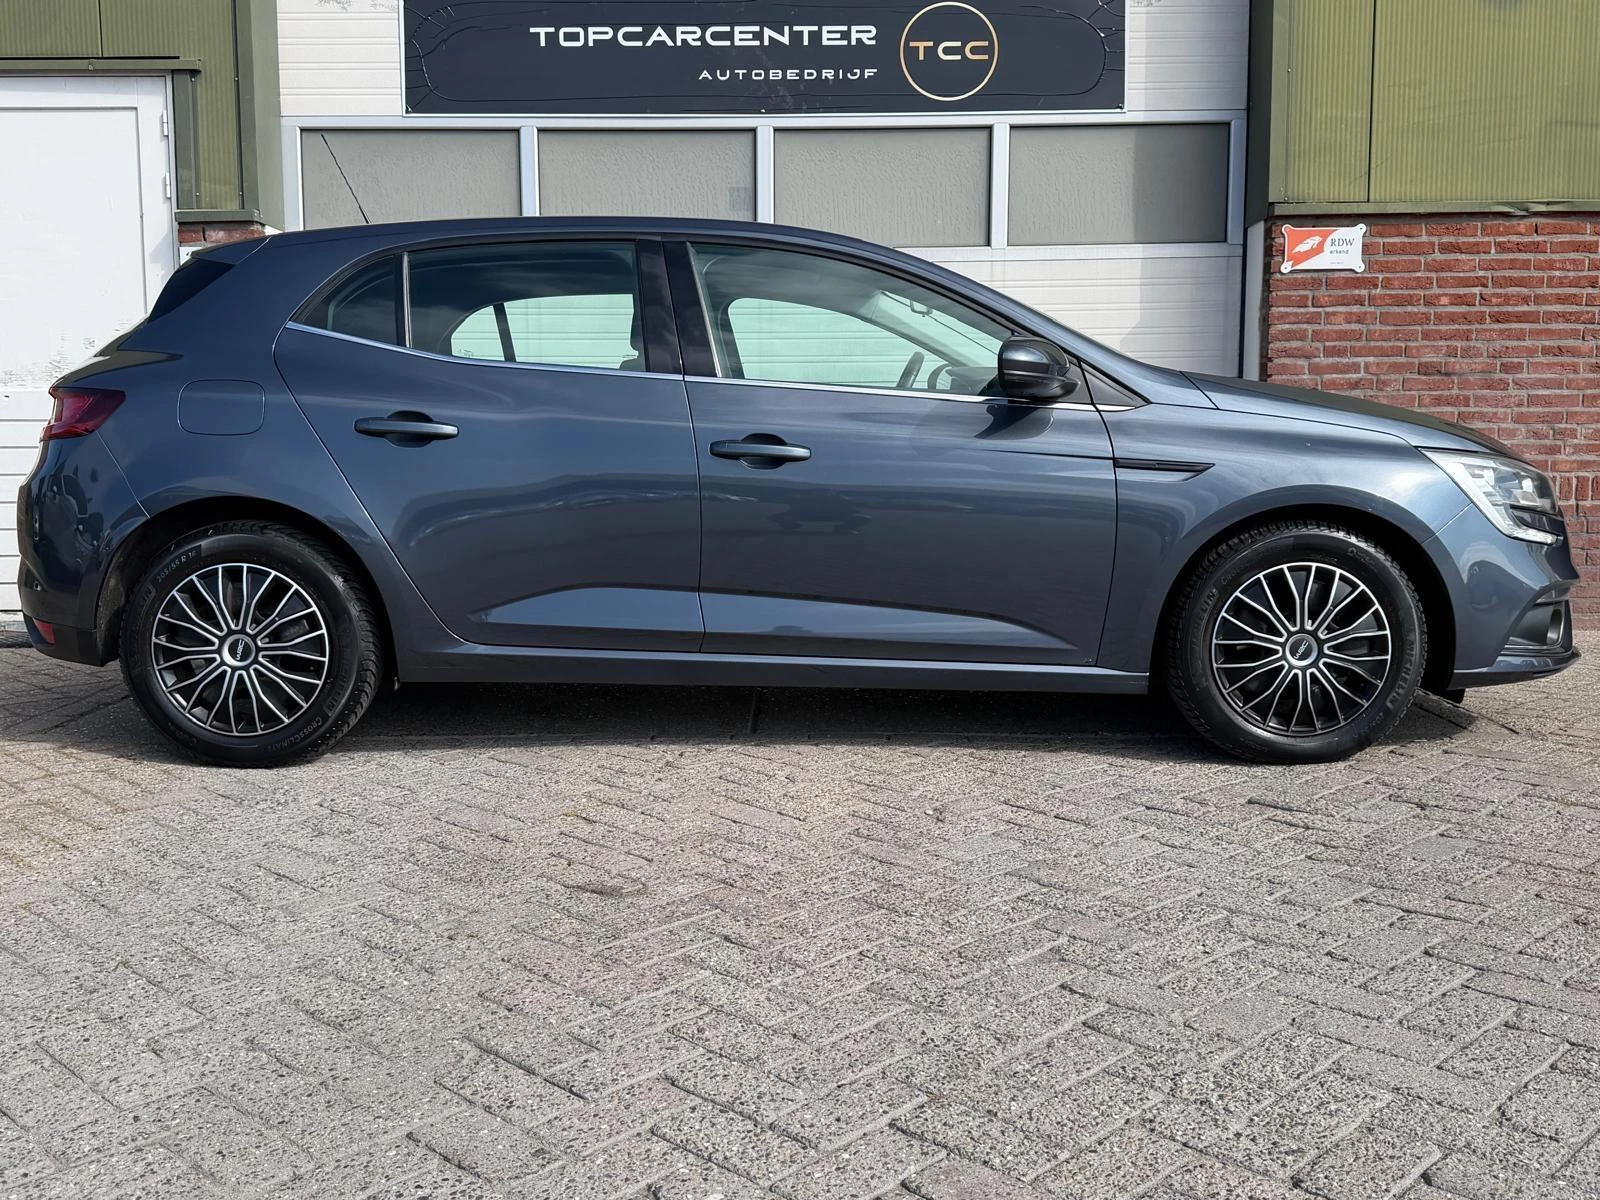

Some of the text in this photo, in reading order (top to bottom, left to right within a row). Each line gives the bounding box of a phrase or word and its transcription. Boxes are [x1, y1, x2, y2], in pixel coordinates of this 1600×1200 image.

[529, 25, 877, 47] TOPCARCENTER
[909, 40, 990, 62] TCC
[698, 68, 878, 81] AUTOBEDRIJF
[1330, 238, 1355, 247] RDW
